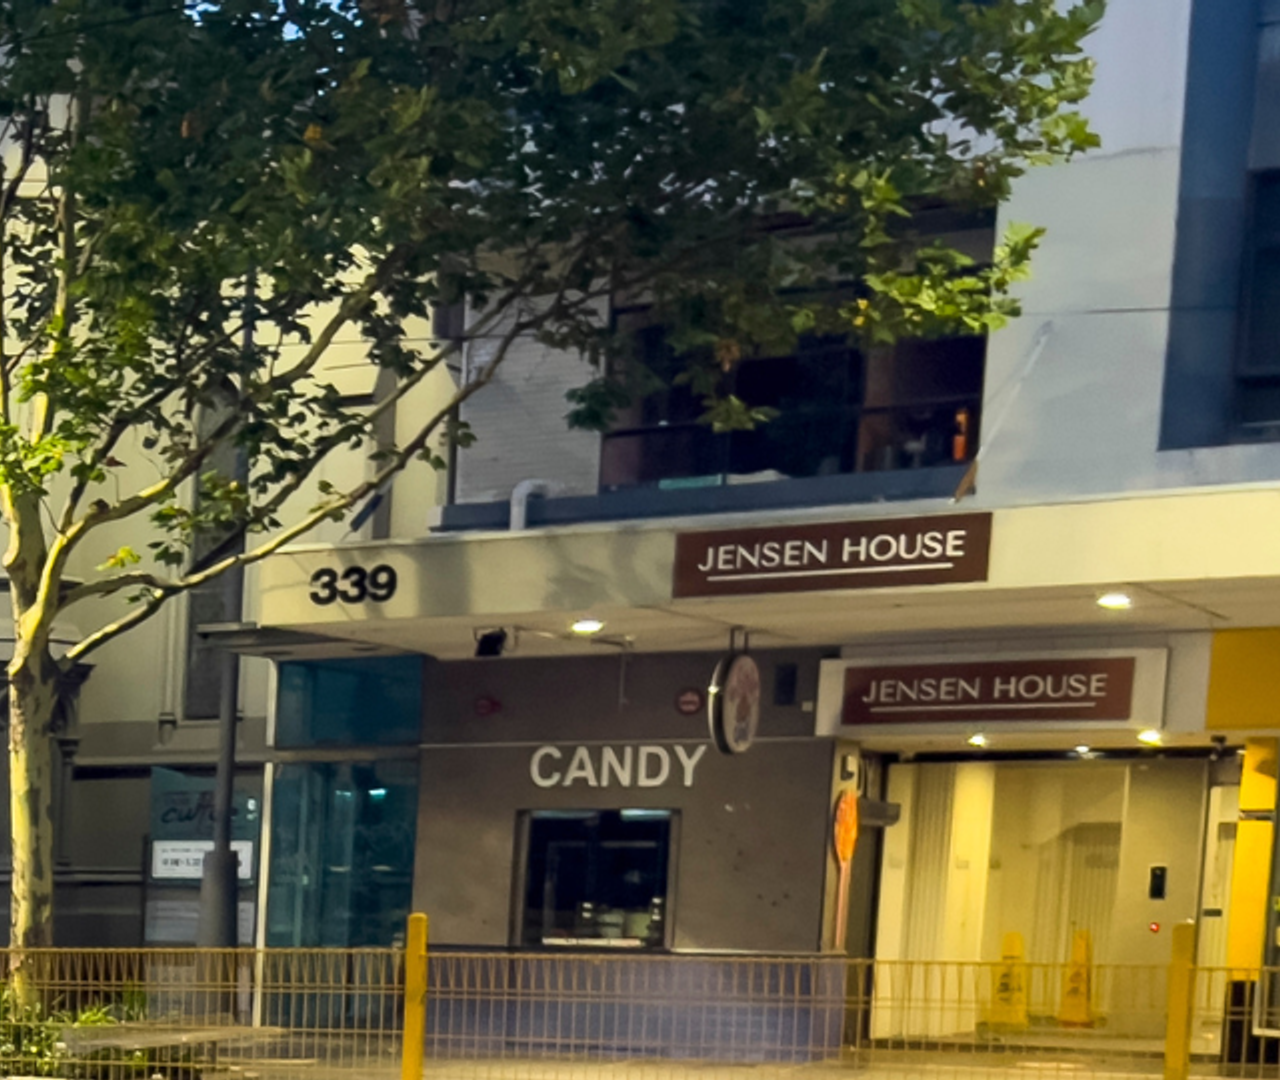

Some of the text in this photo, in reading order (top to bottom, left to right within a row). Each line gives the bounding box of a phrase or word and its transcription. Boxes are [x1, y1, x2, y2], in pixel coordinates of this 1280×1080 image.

[697, 528, 967, 574] JENSEN HOUSE
[308, 564, 398, 605] 339
[862, 673, 1109, 704] JENSEN HOUSE
[530, 745, 707, 788] CANDY
